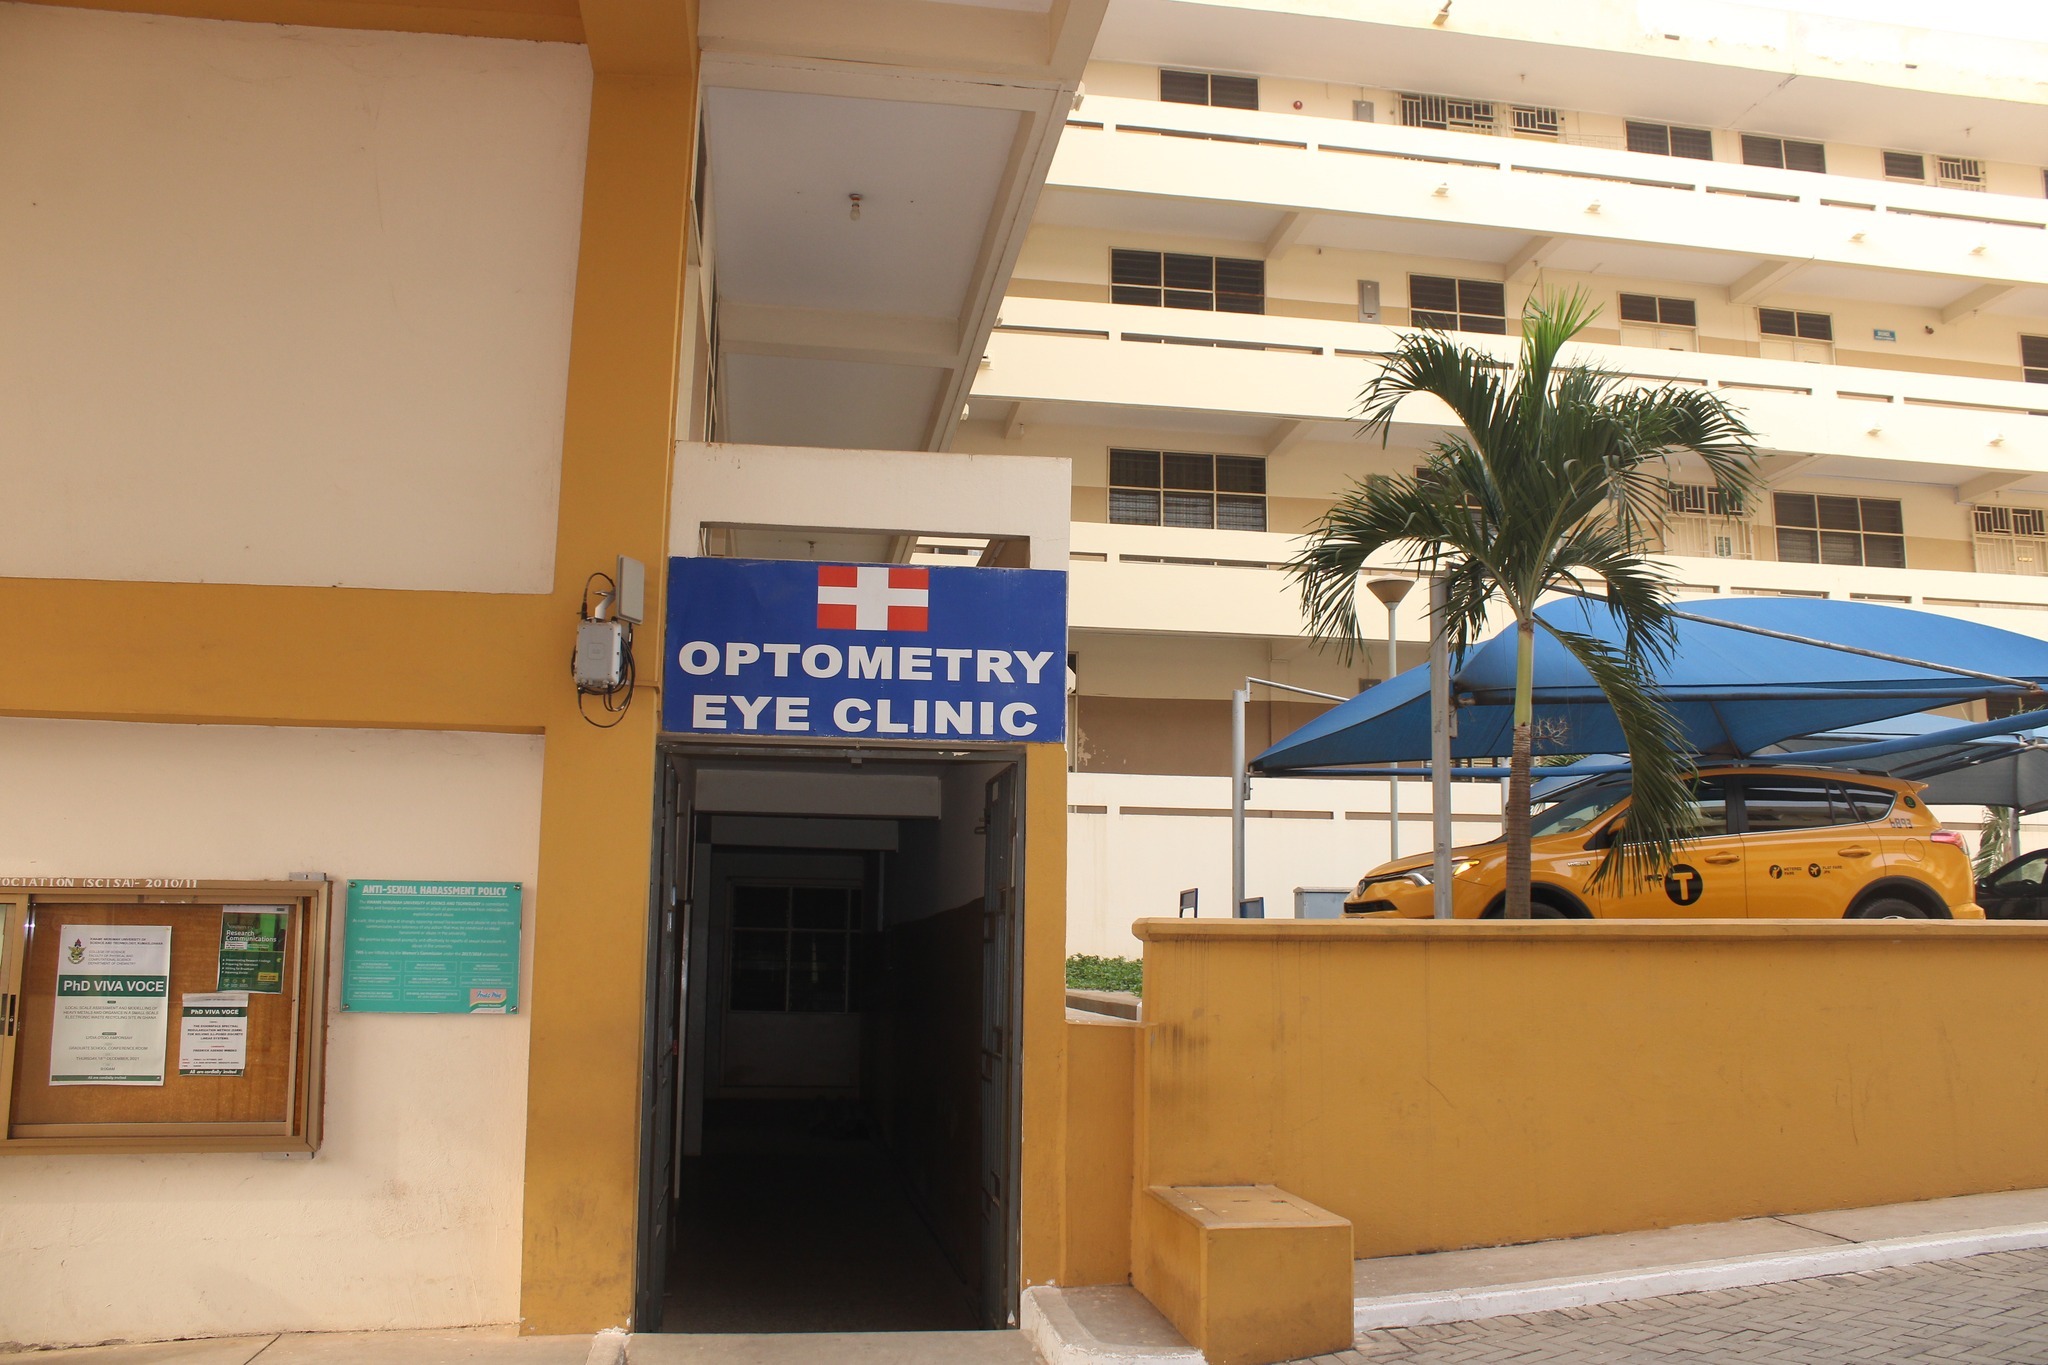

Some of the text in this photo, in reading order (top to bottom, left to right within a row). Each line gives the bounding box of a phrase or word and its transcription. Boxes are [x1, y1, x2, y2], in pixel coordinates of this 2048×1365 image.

[678, 641, 1054, 684] OPTOMETRY
[692, 694, 1038, 737] EYE CLINIC
[145, 879, 198, 888] 2010/11
[362, 884, 507, 897] ANTI-SEXUAL HARASSMENT POLICY
[1672, 872, 1693, 900] T
[63, 980, 165, 992] PhD VIVA VOCE
